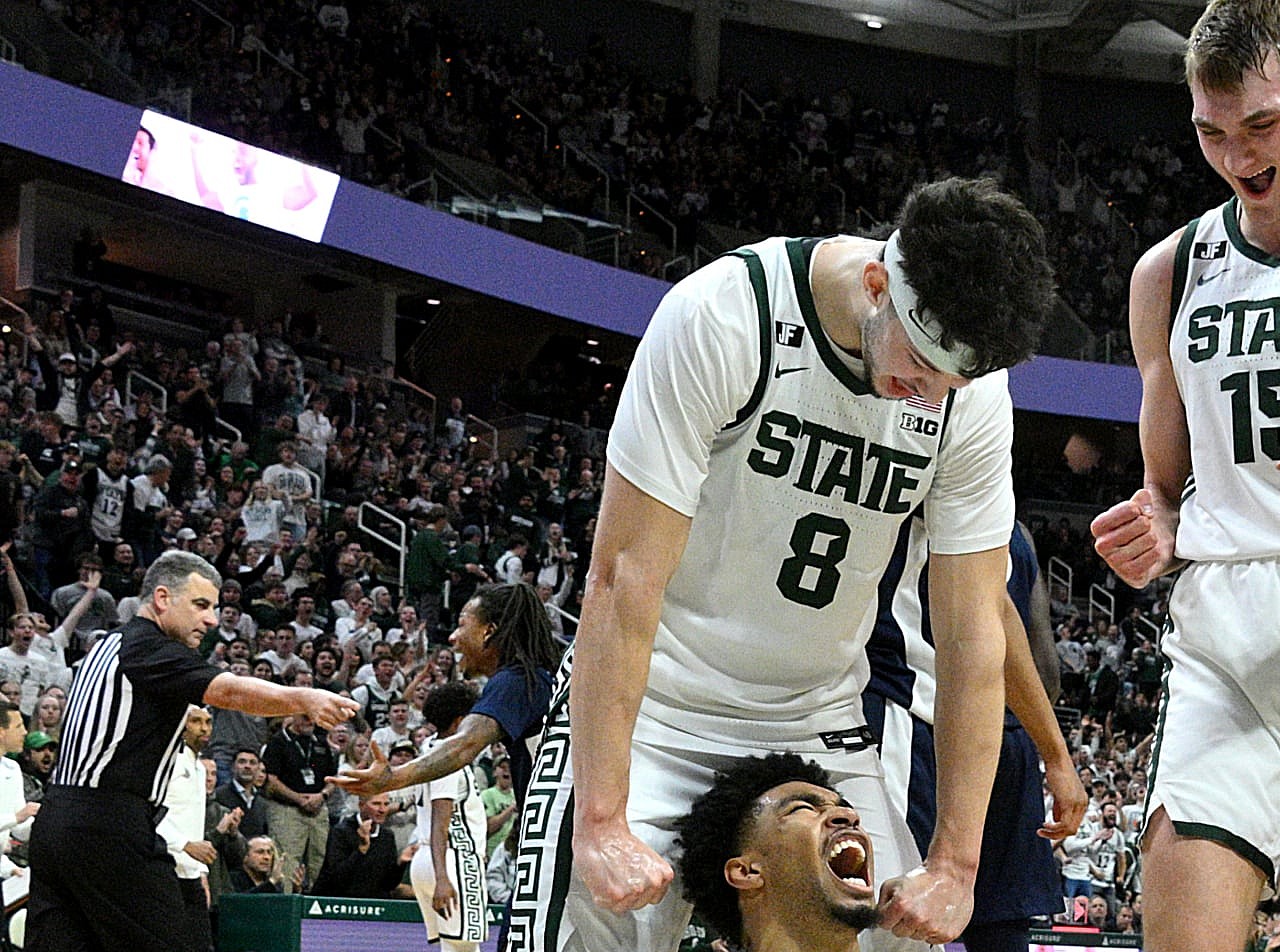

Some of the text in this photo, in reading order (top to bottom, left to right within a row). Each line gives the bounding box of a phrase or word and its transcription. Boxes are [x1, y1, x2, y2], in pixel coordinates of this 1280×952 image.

[777, 324, 798, 346] JF
[747, 409, 931, 514] STATE
[776, 512, 851, 610] 8
[325, 904, 380, 915] ACRISURE
